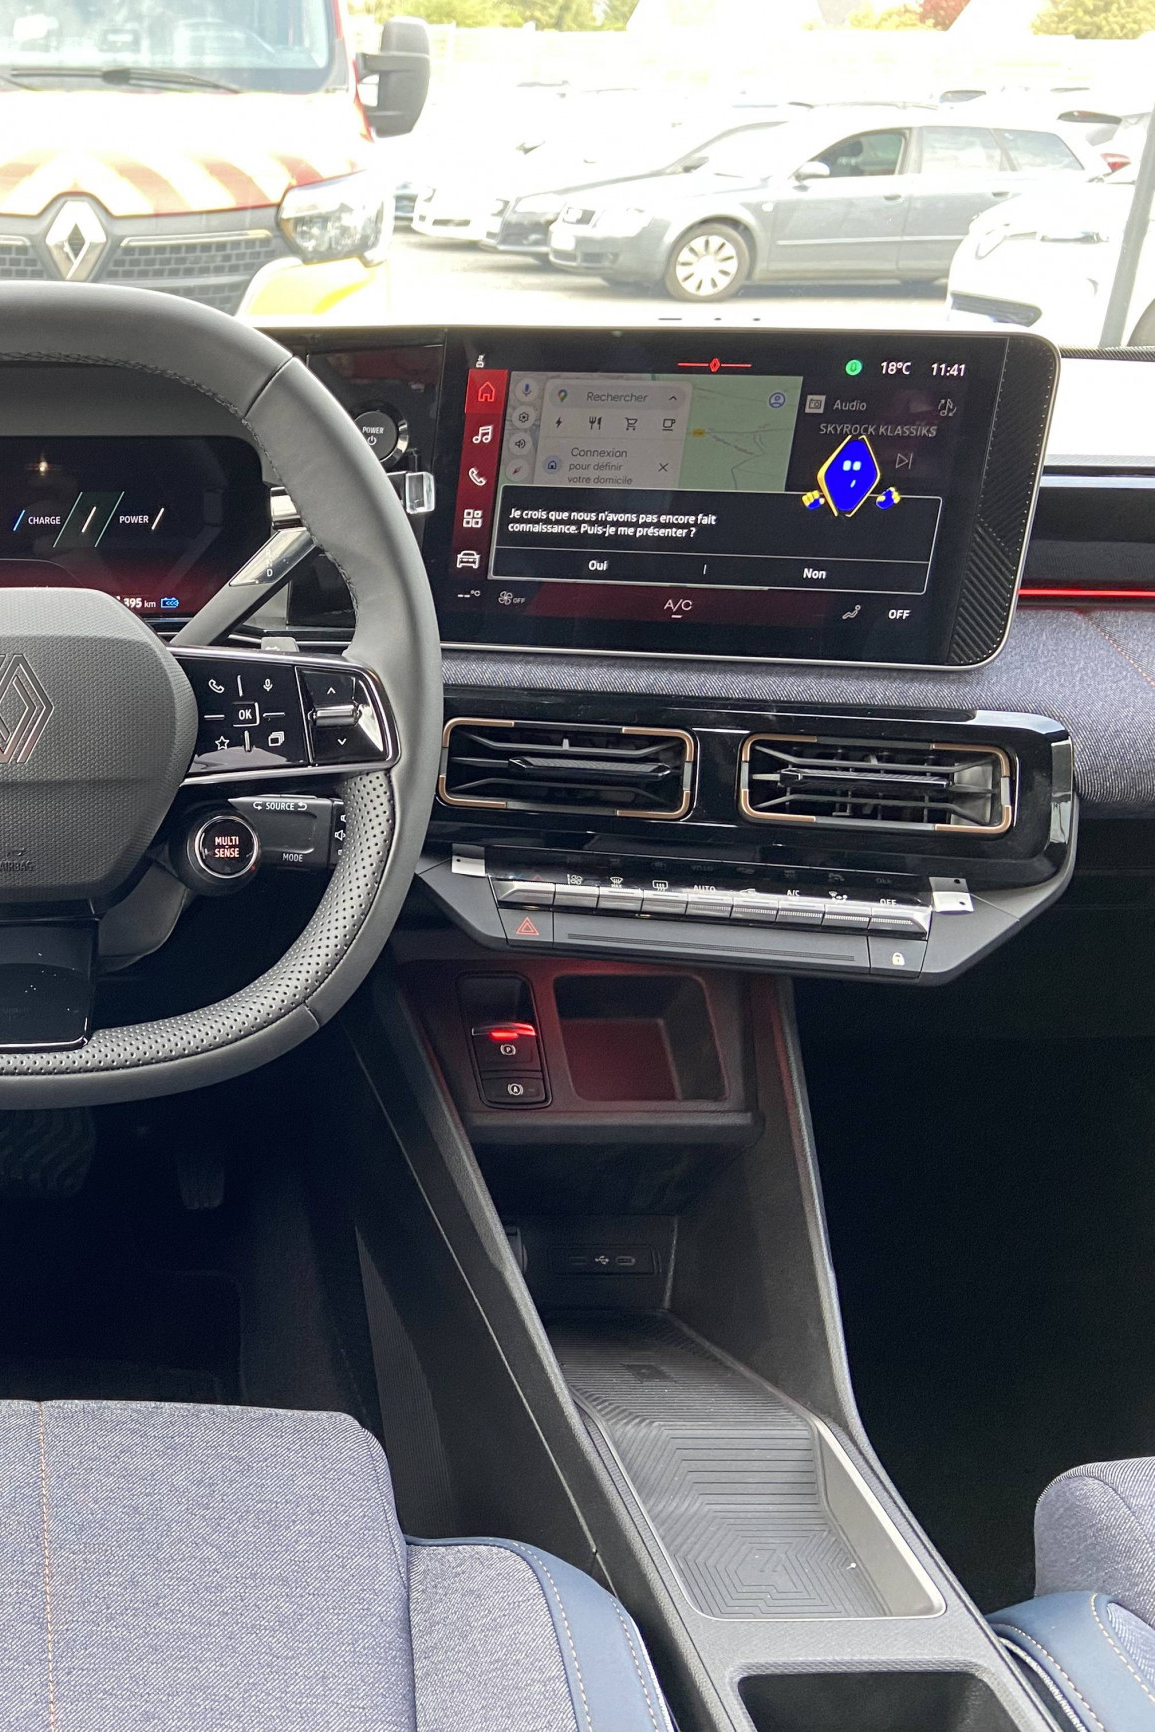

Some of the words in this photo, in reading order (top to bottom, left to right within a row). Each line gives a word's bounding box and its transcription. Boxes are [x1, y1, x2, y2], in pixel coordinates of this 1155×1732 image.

[880, 361, 912, 375] 18°C
[931, 363, 967, 377] 11:41
[586, 391, 648, 403] Rechercher
[833, 399, 867, 411] Audio
[362, 426, 384, 434] POWER
[819, 423, 876, 436] SKYROCK
[878, 425, 937, 437] KLASSIKS
[570, 447, 628, 458] Connexion
[568, 463, 590, 472] pour
[592, 461, 623, 472] définir
[567, 476, 593, 484] votre
[594, 475, 633, 486] domicile
[27, 516, 61, 525] CHARGE
[119, 515, 149, 524] POWER
[509, 507, 521, 519] Je
[522, 508, 547, 519] crois
[548, 511, 569, 523] que
[570, 511, 596, 521] nous
[598, 510, 637, 523] n'avons
[638, 513, 658, 524] pas
[660, 514, 696, 525] encore
[697, 513, 716, 525] fait
[508, 522, 578, 534] connaissance.
[580, 524, 616, 537] Puis-je
[617, 526, 635, 536] me
[636, 525, 688, 538] présenter
[689, 527, 696, 538] ?
[588, 560, 608, 571] Oui
[266, 568, 273, 577] D
[803, 568, 827, 579] Non
[144, 600, 156, 608] km
[664, 598, 693, 612] A/C
[888, 609, 911, 620] OFF
[238, 709, 252, 720] OK
[266, 802, 295, 811] SOURCE
[214, 836, 239, 846] MULTI
[214, 848, 240, 858] SENSE
[283, 853, 303, 862] MODE
[0, 860, 34, 872] AIRBAG
[693, 884, 716, 892] AUTO
[786, 889, 801, 897] A/C
[880, 898, 896, 906] OFF
